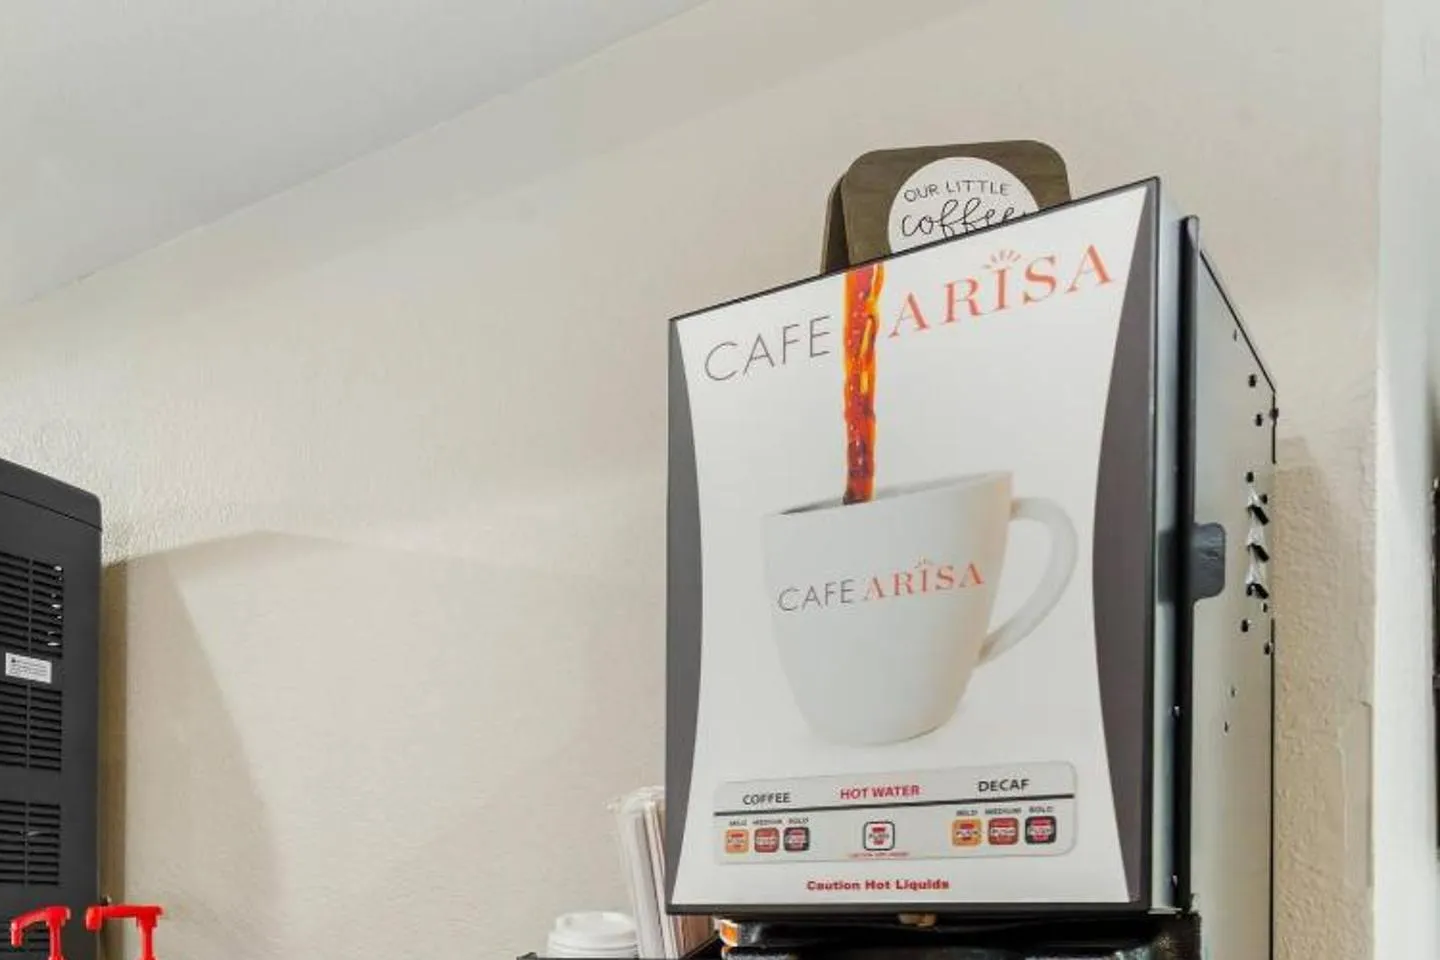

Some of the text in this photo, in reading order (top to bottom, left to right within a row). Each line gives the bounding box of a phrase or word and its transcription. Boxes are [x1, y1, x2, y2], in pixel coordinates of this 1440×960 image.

[904, 180, 1010, 202] OUR LITTLE
[902, 197, 1015, 238] coffee
[705, 315, 831, 381] CAFE
[777, 578, 855, 612] CAFE
[840, 784, 920, 799] HOT WATER
[978, 779, 1030, 792] DECAF
[742, 792, 791, 805] COFFEE
[806, 878, 950, 891] Caution Hot Liquids
